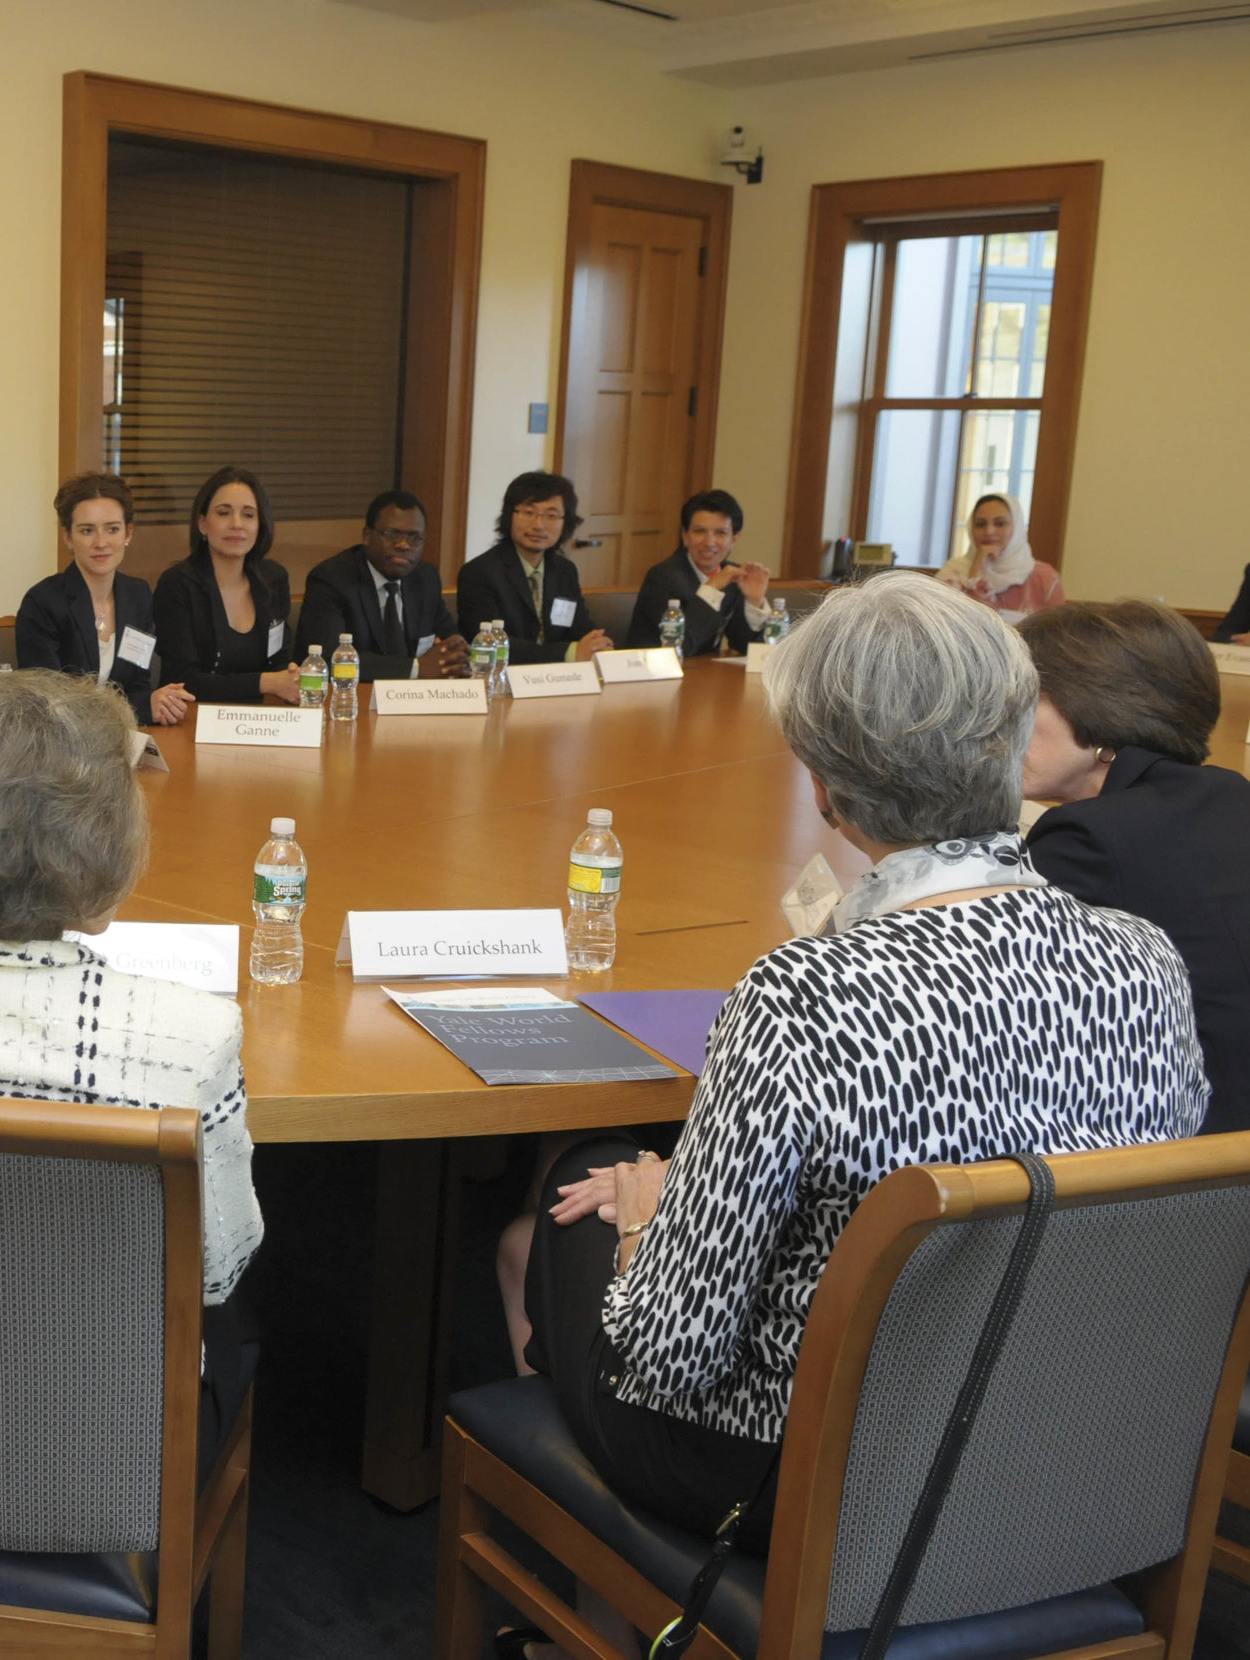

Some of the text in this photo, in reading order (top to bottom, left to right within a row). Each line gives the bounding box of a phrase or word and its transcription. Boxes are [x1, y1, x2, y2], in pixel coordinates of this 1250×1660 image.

[385, 688, 479, 700] Corina Machado
[217, 708, 301, 723] Emmanuelle
[235, 723, 280, 737] Ganne
[273, 885, 302, 897] Spring
[378, 939, 543, 957] Laura Cruickshank
[115, 952, 214, 976] Greenberg
[428, 1014, 574, 1026] Yale World
[438, 1024, 542, 1036] Fellows
[451, 1034, 570, 1048] Program
